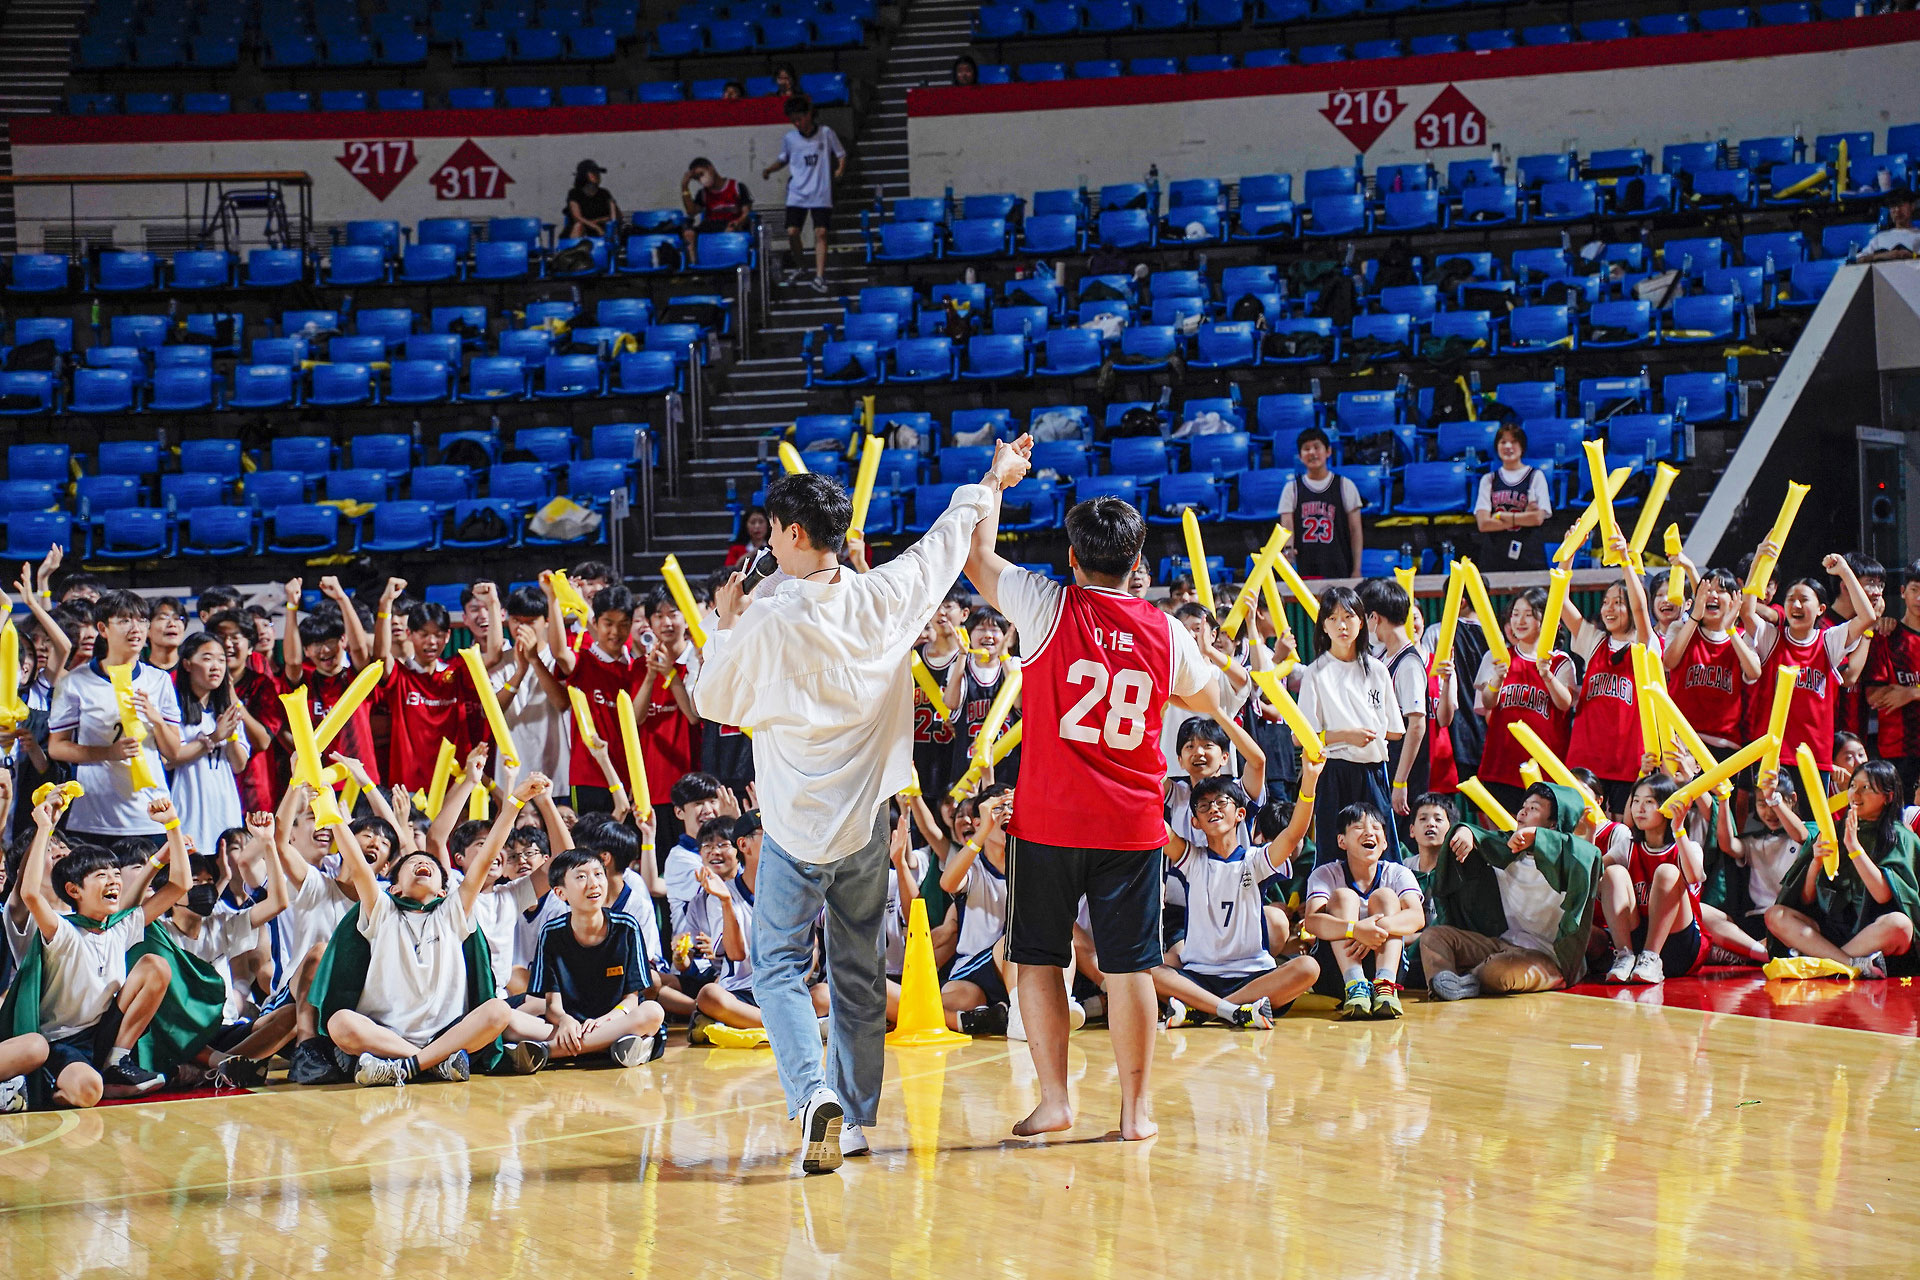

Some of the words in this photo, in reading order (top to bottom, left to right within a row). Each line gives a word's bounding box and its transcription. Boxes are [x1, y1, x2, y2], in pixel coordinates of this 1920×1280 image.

[1333, 90, 1393, 126] 216
[1420, 111, 1481, 147] 316
[349, 141, 409, 174] 217
[440, 166, 500, 199] 317
[1301, 500, 1336, 520] BULLS
[1302, 516, 1335, 544] 23
[1094, 627, 1135, 652] 0.1톤
[1058, 658, 1154, 751] 28
[914, 707, 954, 744] 23
[1221, 901, 1234, 928] 7
